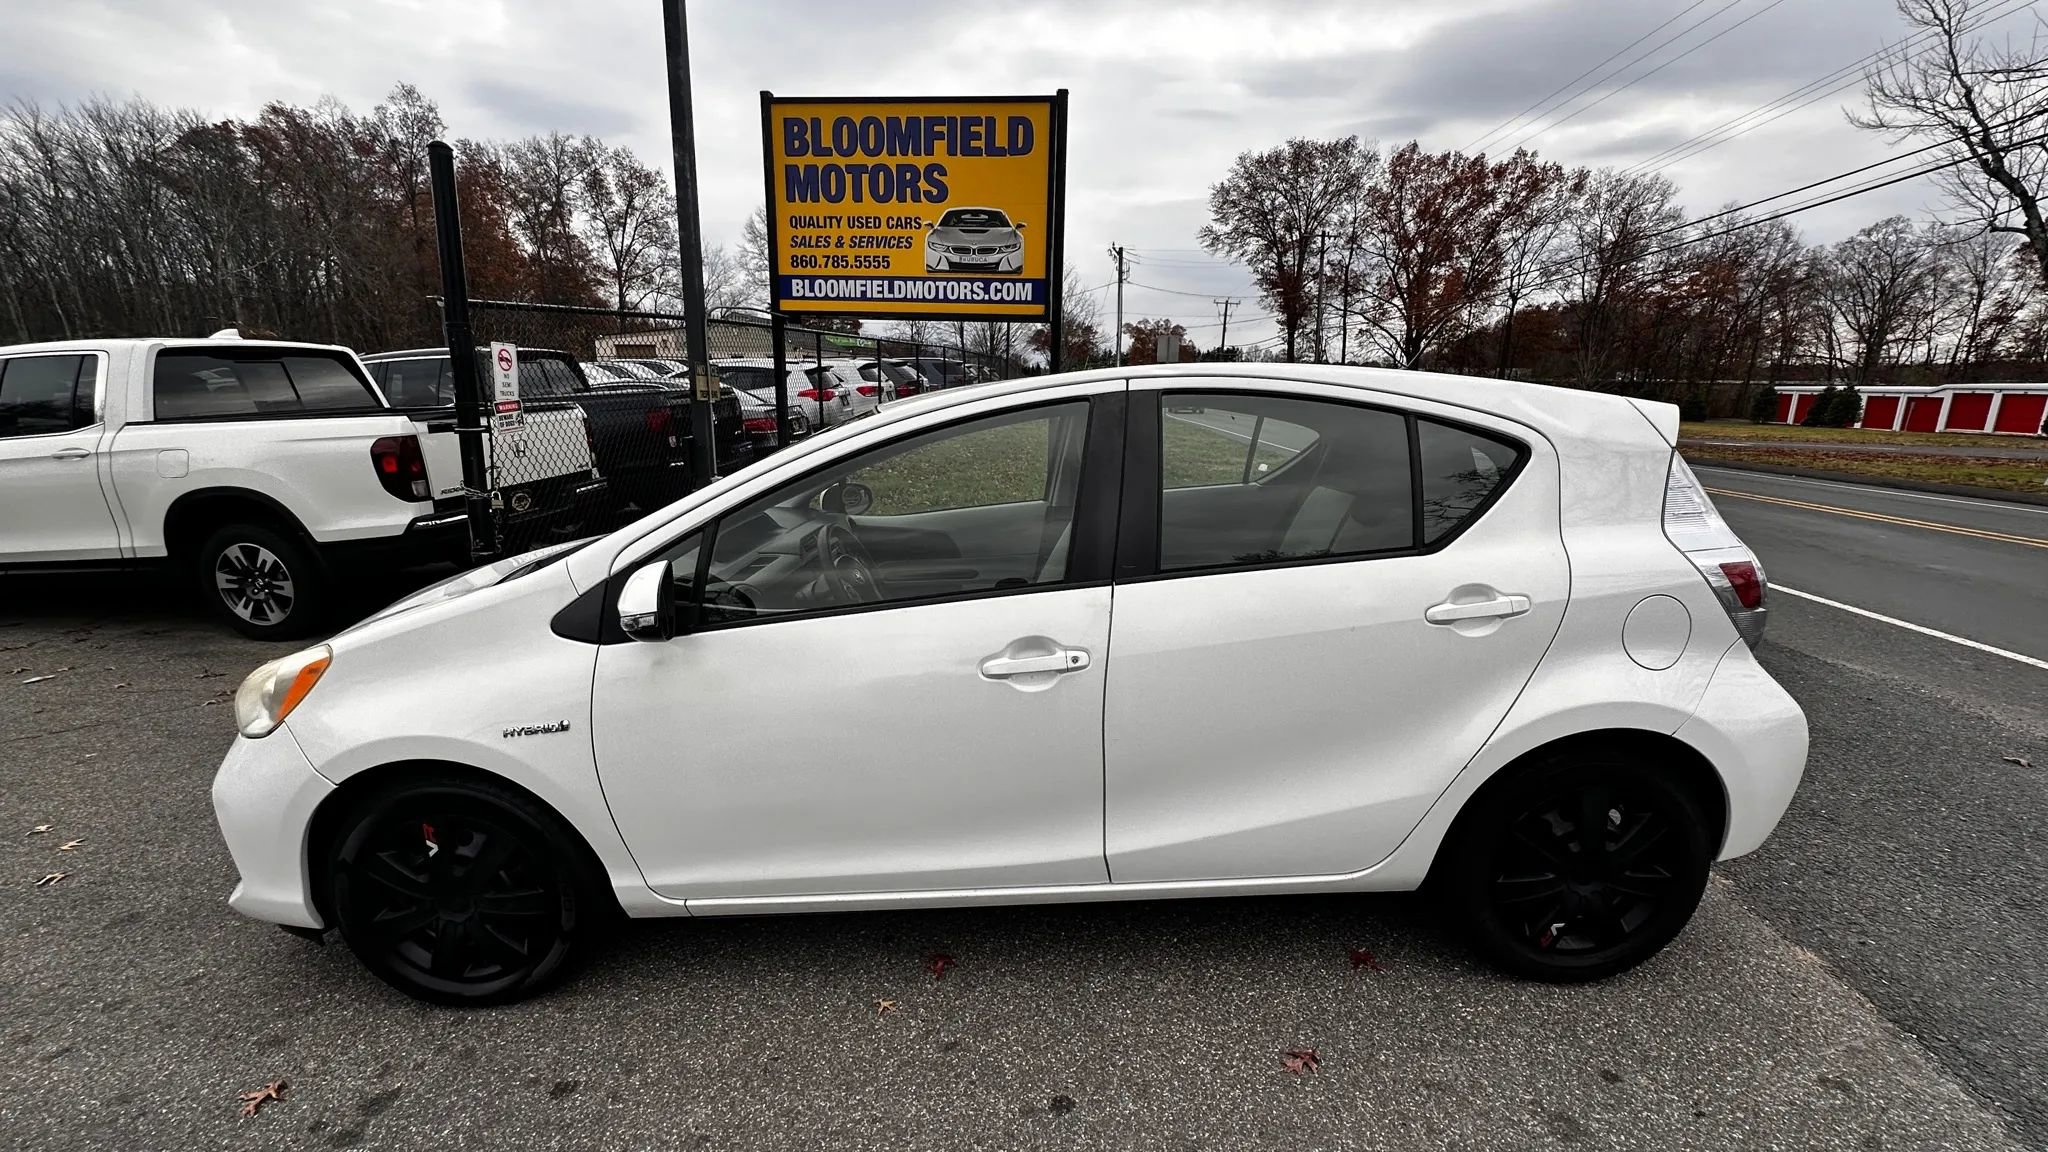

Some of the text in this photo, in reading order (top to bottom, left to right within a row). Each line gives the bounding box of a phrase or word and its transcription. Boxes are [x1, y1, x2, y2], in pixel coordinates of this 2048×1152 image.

[783, 116, 1034, 157] BLOOMFIELD
[785, 164, 949, 204] MOTORS
[789, 216, 922, 230] QUALITY USED CARS
[790, 235, 914, 249] SALES & SERVICES
[790, 255, 891, 269] 860.785.5555
[791, 279, 1033, 301] BLOOMFIELDMOTORS.COM
[498, 403, 518, 411] WARNING
[503, 722, 559, 738] HYBRID
